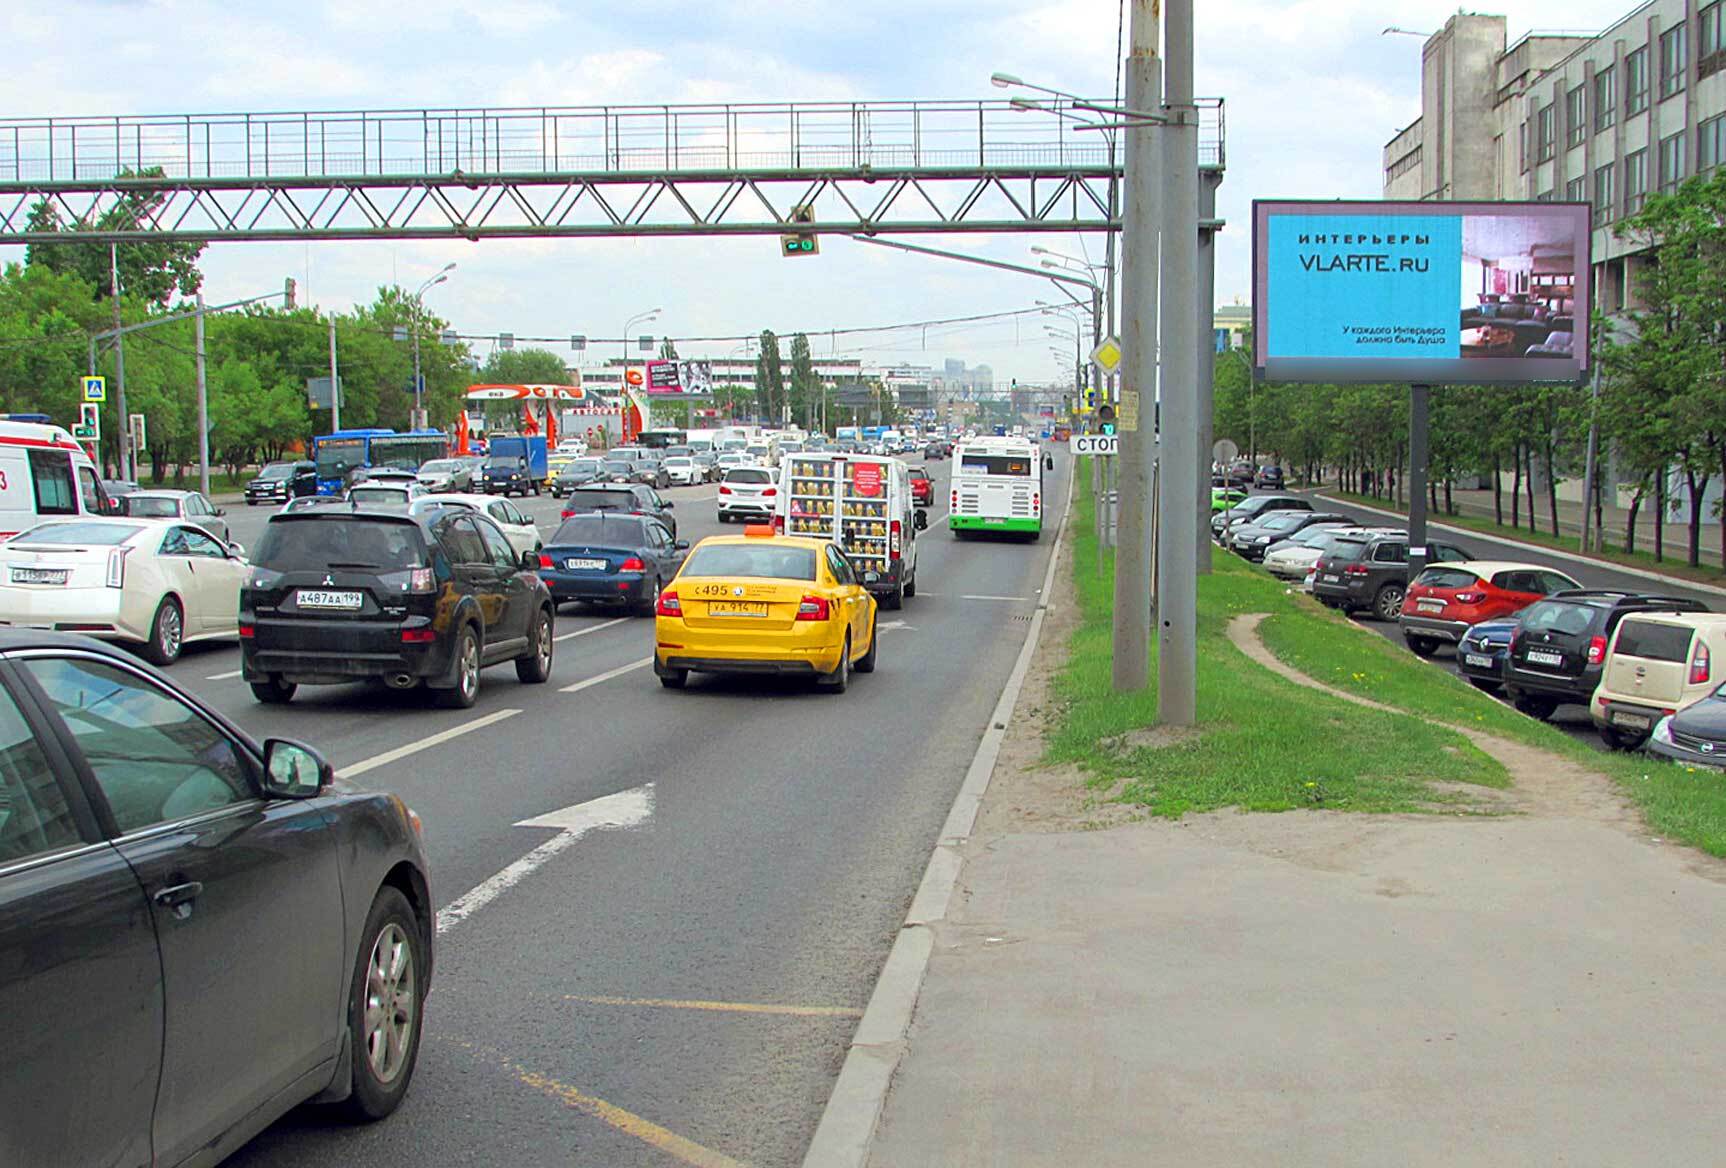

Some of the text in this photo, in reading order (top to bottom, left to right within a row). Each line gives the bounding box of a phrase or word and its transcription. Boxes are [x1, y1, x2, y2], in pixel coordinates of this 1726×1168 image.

[1299, 234, 1430, 244] ИНТЕРЬЕРЫ
[1299, 254, 1429, 272] VLARTE.RU
[1343, 325, 1446, 336] У каждого Интерьера
[1394, 335, 1416, 345] быть
[1417, 335, 1446, 346] Душа
